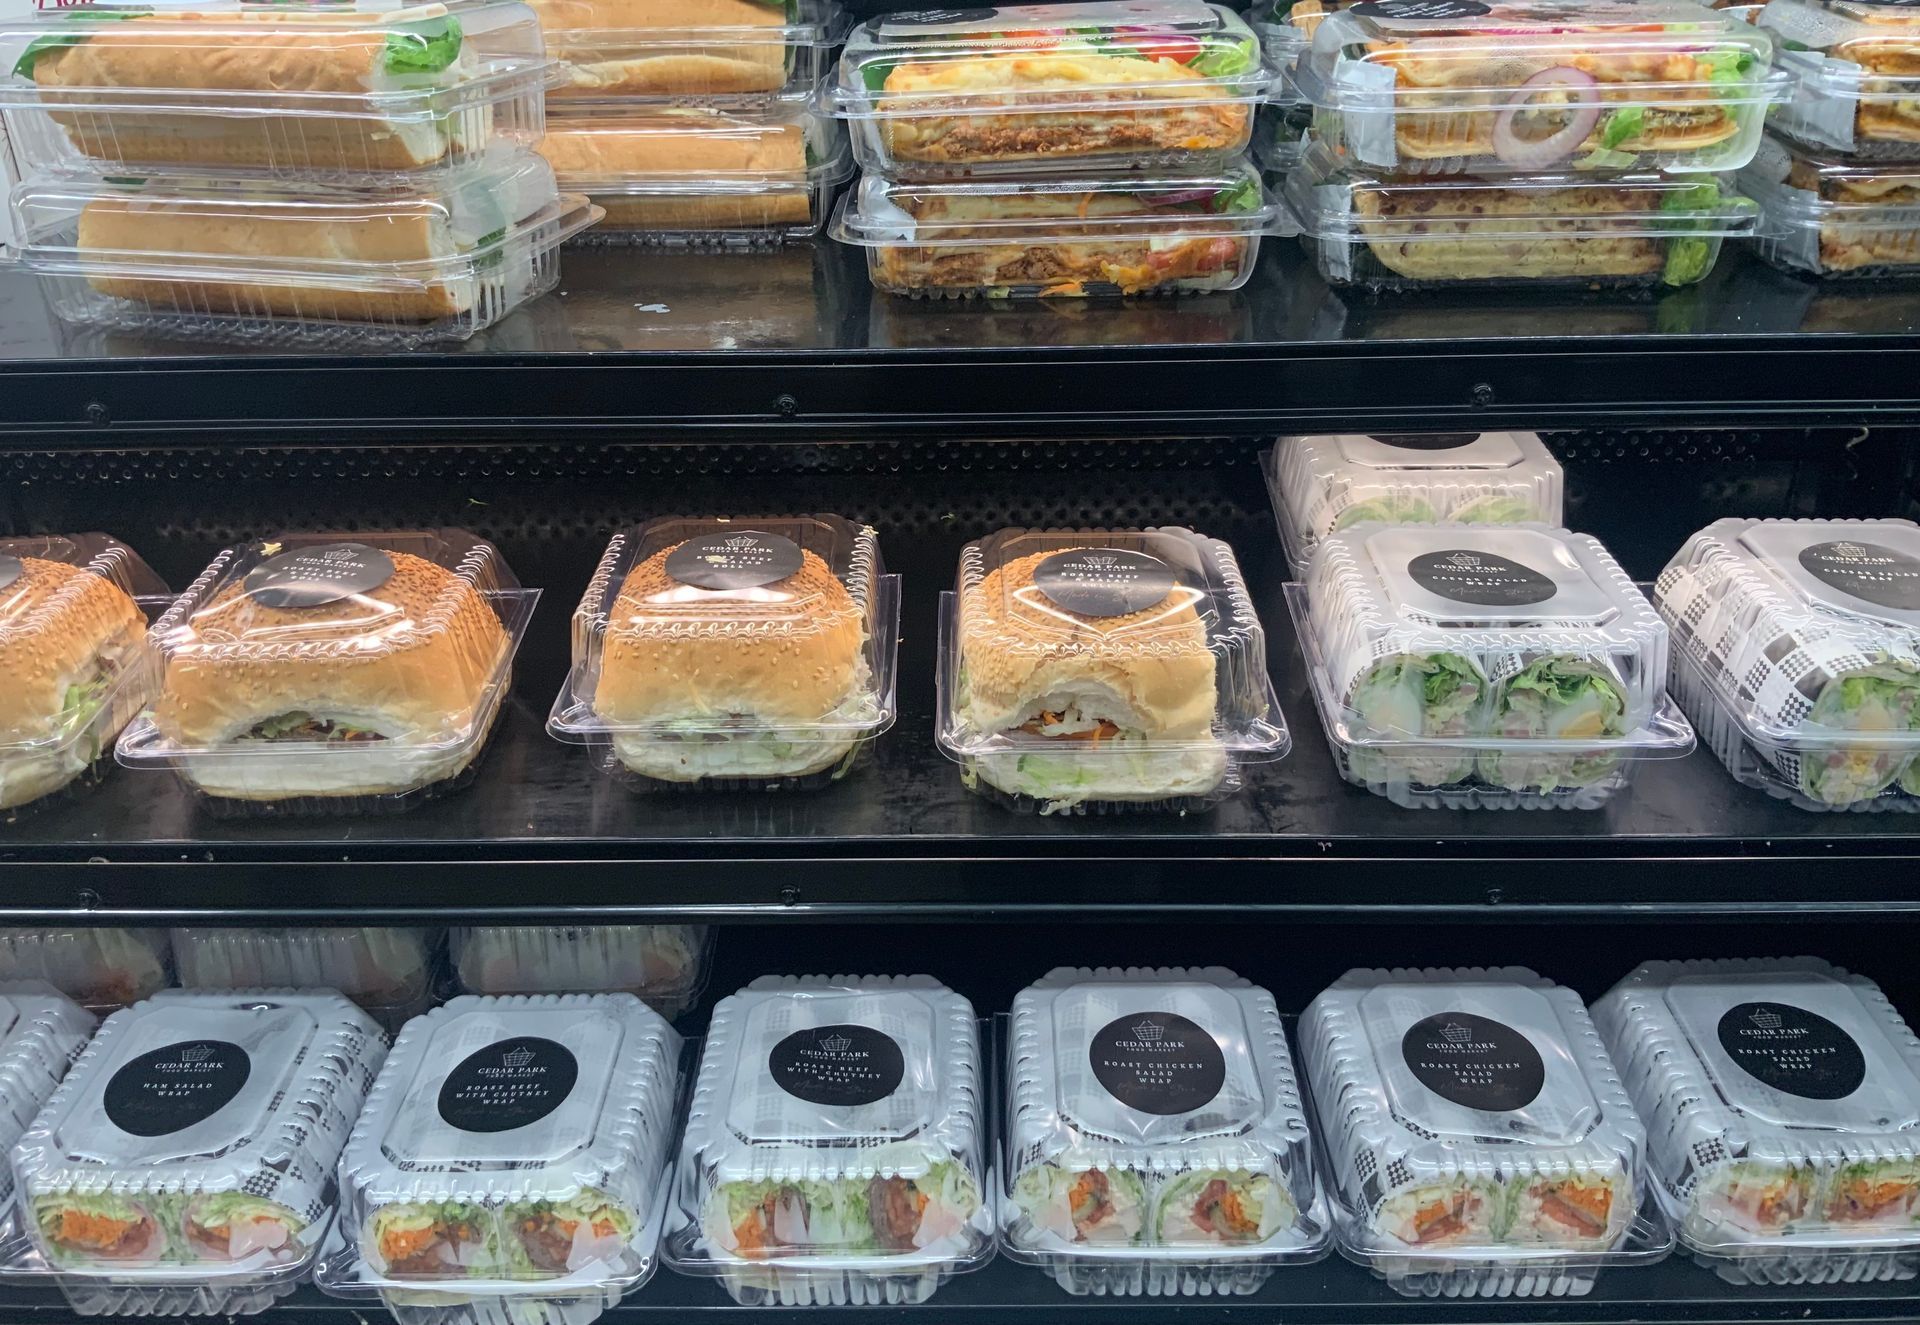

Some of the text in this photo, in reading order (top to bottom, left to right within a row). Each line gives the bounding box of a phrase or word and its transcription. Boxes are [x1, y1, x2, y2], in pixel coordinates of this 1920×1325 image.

[336, 560, 366, 568] PARK
[1739, 1028, 1776, 1036] CEDAR
[1115, 1040, 1152, 1048] CEDAR
[800, 1049, 836, 1057] CEDAR
[1782, 1047, 1837, 1055] CHICKEN
[795, 1062, 833, 1070] ROAST
[1104, 1060, 1141, 1068] ROAST
[825, 1070, 881, 1079] CHUTNEY
[817, 1075, 850, 1083] WRAP
